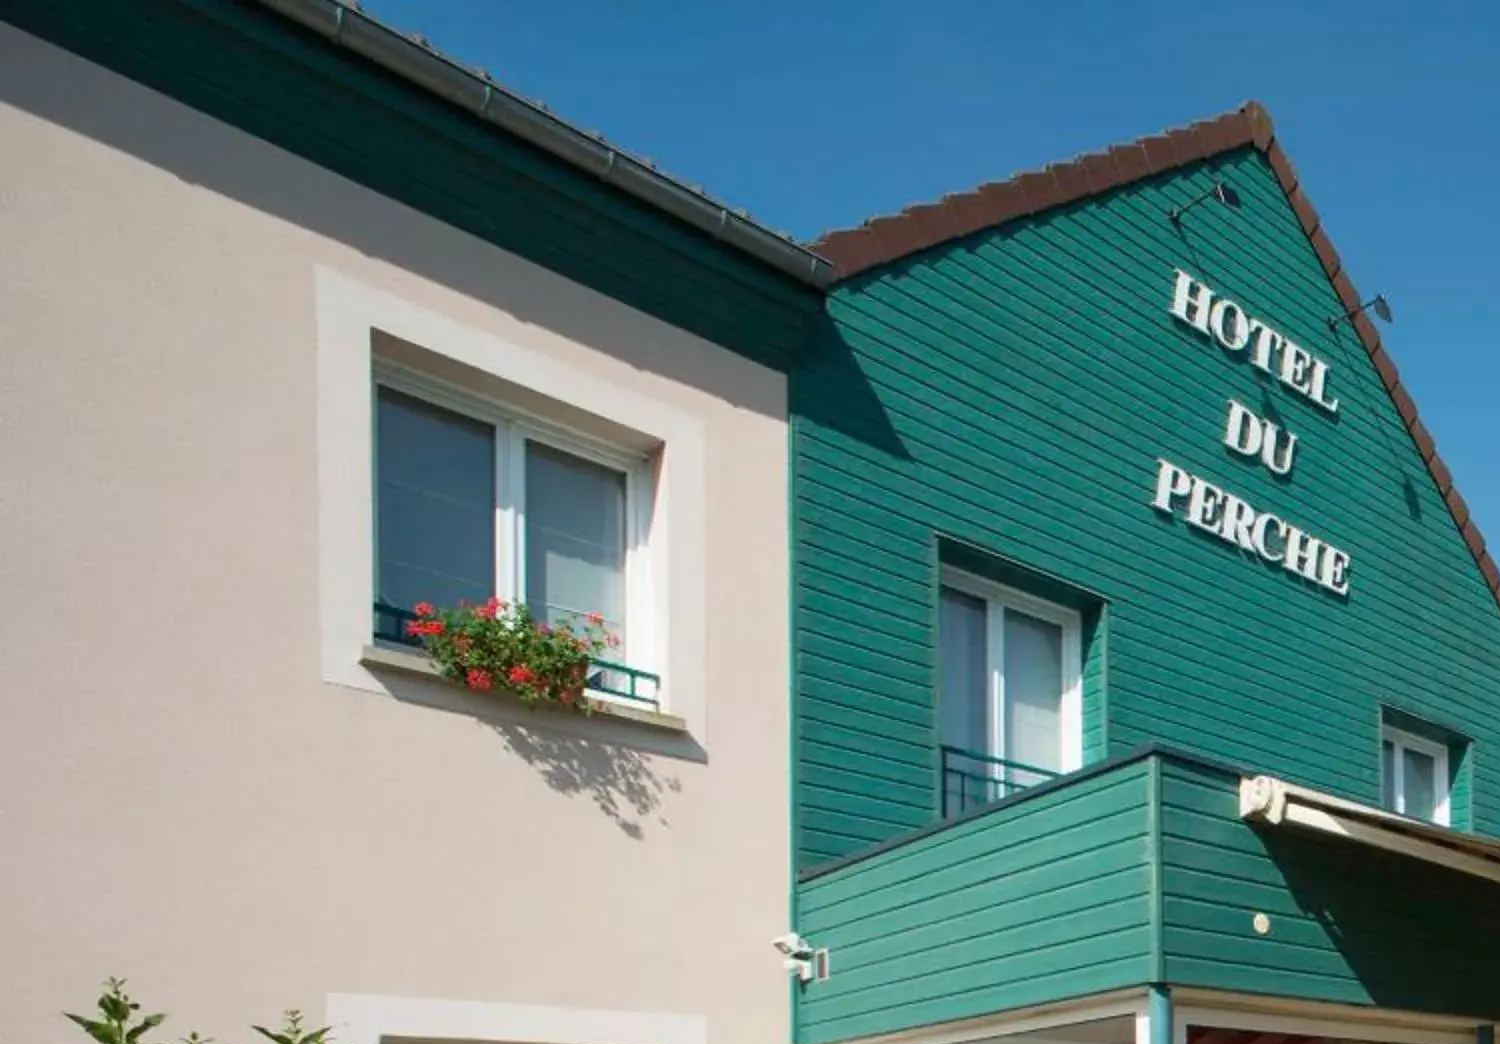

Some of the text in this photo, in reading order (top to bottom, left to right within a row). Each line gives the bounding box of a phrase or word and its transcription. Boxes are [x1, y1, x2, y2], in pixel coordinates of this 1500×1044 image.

[1168, 268, 1339, 412] HOTEL
[1222, 399, 1298, 475] DU
[1151, 458, 1351, 596] PERCHE
